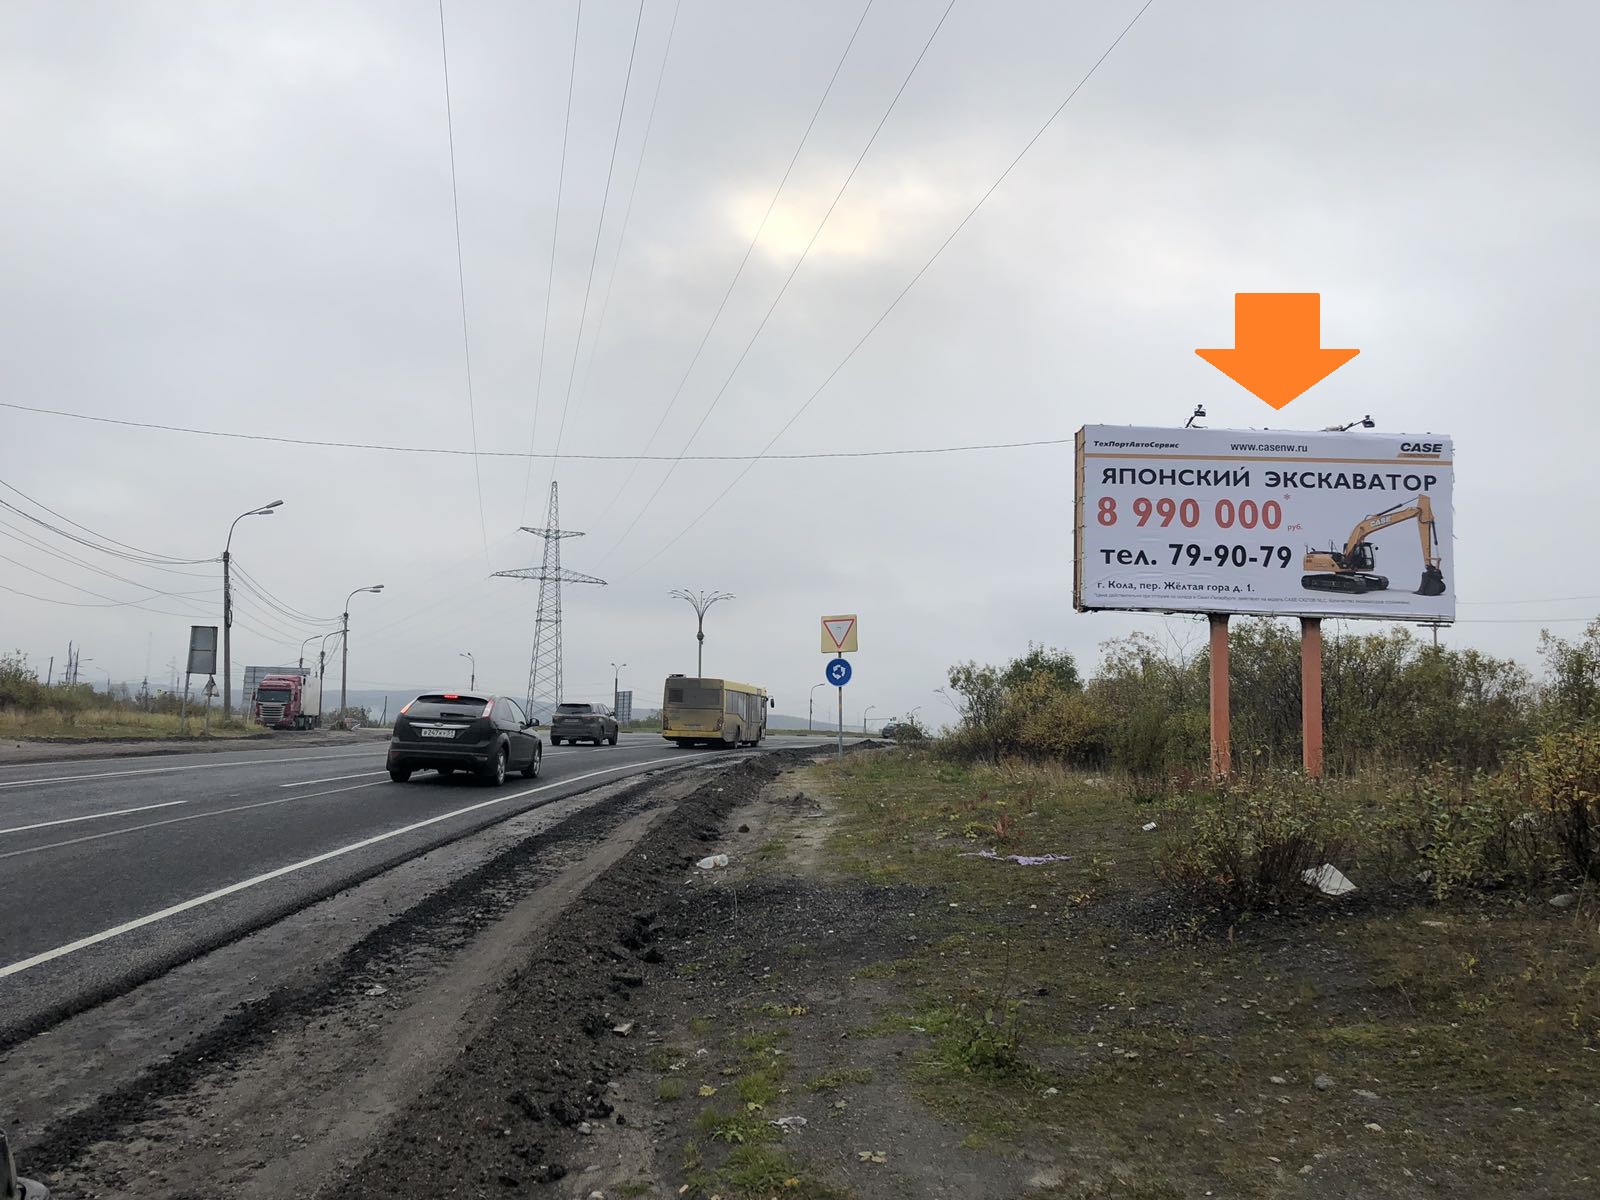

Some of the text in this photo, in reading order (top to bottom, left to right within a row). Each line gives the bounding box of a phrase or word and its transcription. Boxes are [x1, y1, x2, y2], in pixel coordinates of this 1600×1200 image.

[1094, 441, 1179, 449] ТехПортАвтоСервис
[1230, 443, 1308, 452] www.casenw.ru
[1400, 442, 1443, 453] CASE
[1101, 466, 1437, 491] ЯПОНСКИЙ ЭКСКАВАТОР
[1097, 497, 1118, 526] 8
[1132, 497, 1200, 528] 990
[1287, 523, 1303, 532] руб.
[1100, 543, 1292, 569] тел. 79-90-79
[1108, 580, 1137, 590] Кола,
[1139, 583, 1161, 591] пер.
[1164, 581, 1204, 591] Жёлтая
[1206, 584, 1230, 593] гора
[1246, 583, 1255, 592] 1.
